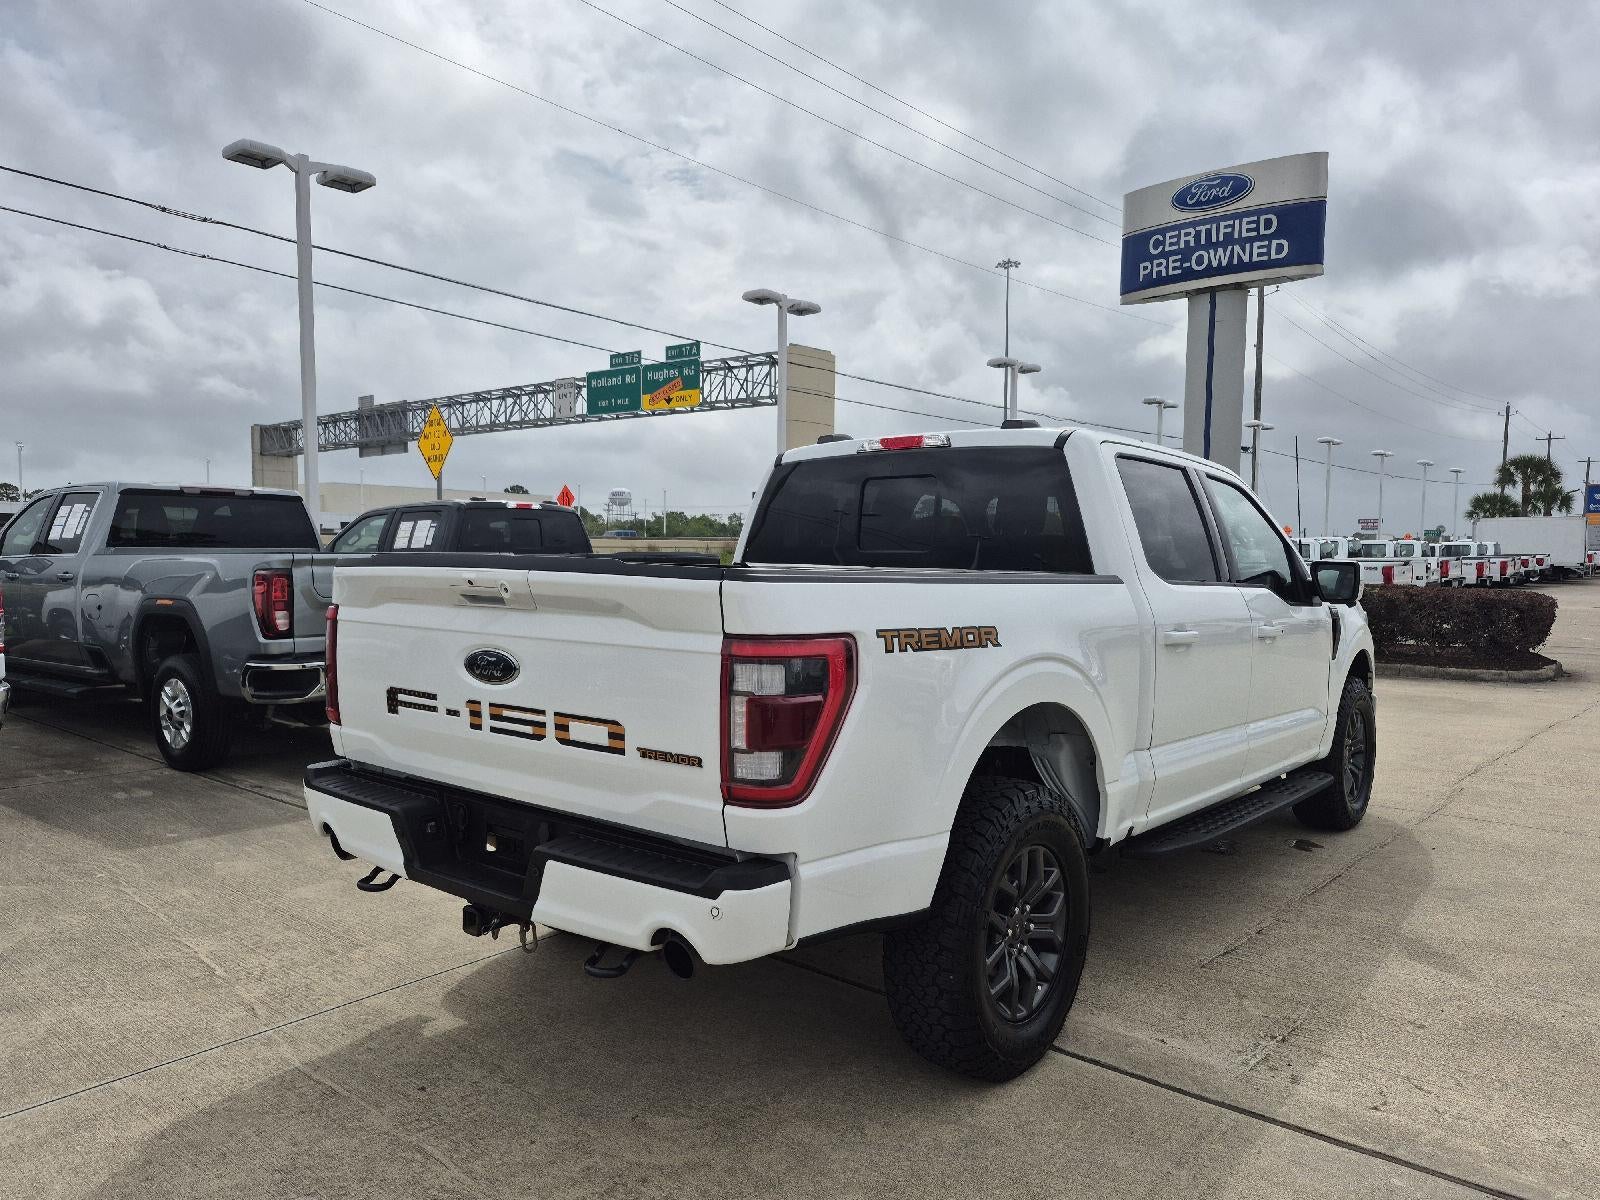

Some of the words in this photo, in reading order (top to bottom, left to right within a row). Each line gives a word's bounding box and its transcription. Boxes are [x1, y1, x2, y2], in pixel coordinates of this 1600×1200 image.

[1187, 178, 1233, 205] Ford
[1149, 213, 1278, 255] CERTIFIED
[1139, 238, 1289, 281] PRE-OWNED
[591, 376, 622, 388] Holland
[625, 373, 636, 384] Rd
[647, 368, 679, 381] Hughes
[683, 365, 695, 376] Rd
[556, 382, 574, 391] SPEED
[675, 394, 693, 403] ONLY
[876, 626, 1002, 653] TREMOR
[387, 687, 625, 756] F-150
[636, 746, 704, 769] TREMOR
